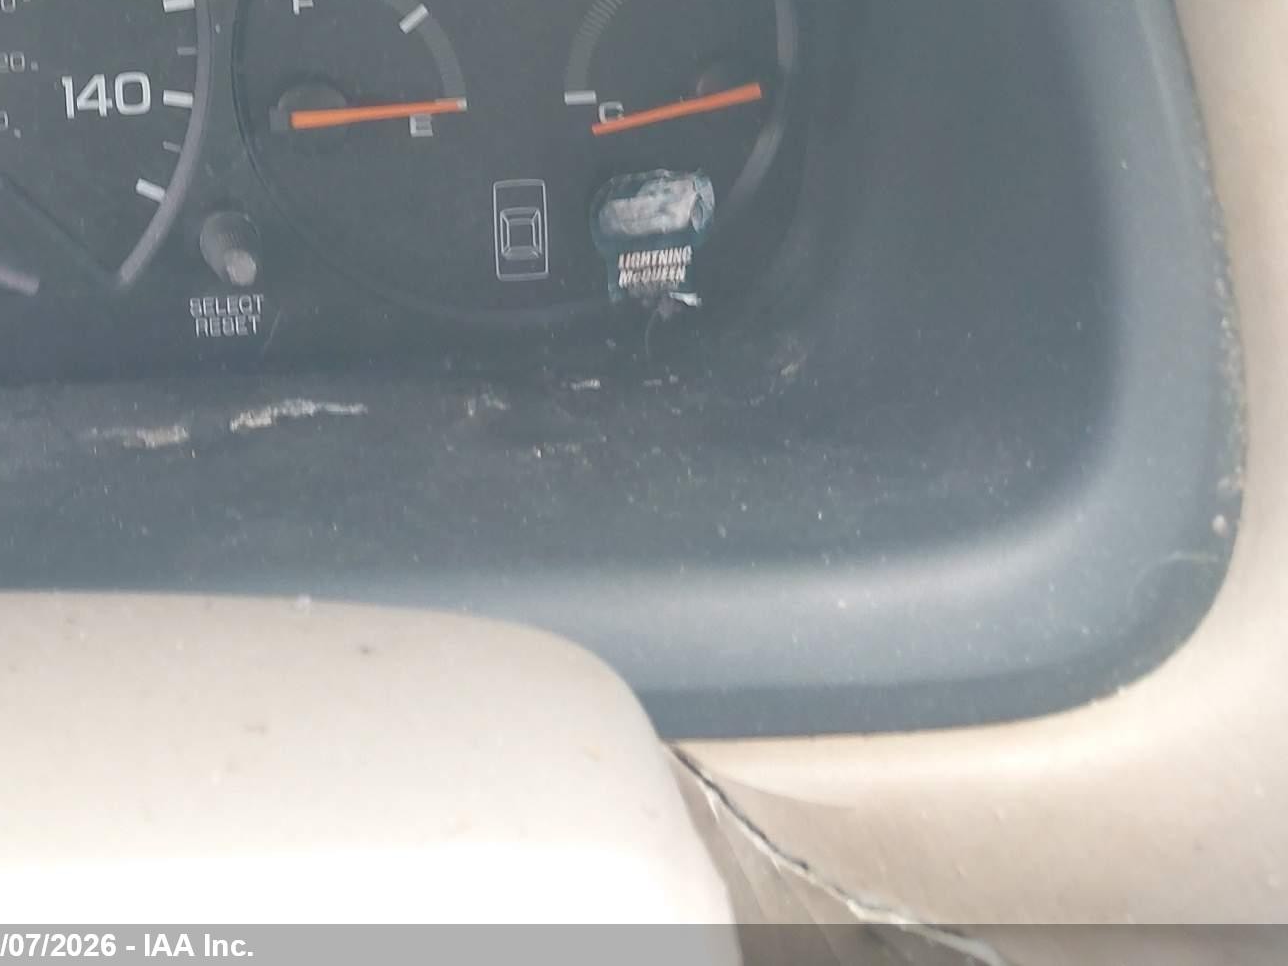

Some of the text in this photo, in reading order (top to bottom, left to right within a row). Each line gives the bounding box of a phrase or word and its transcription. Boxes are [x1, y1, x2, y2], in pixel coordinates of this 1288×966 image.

[62, 73, 150, 118] 140
[190, 294, 264, 317] SELECT
[195, 314, 261, 337] RESET
